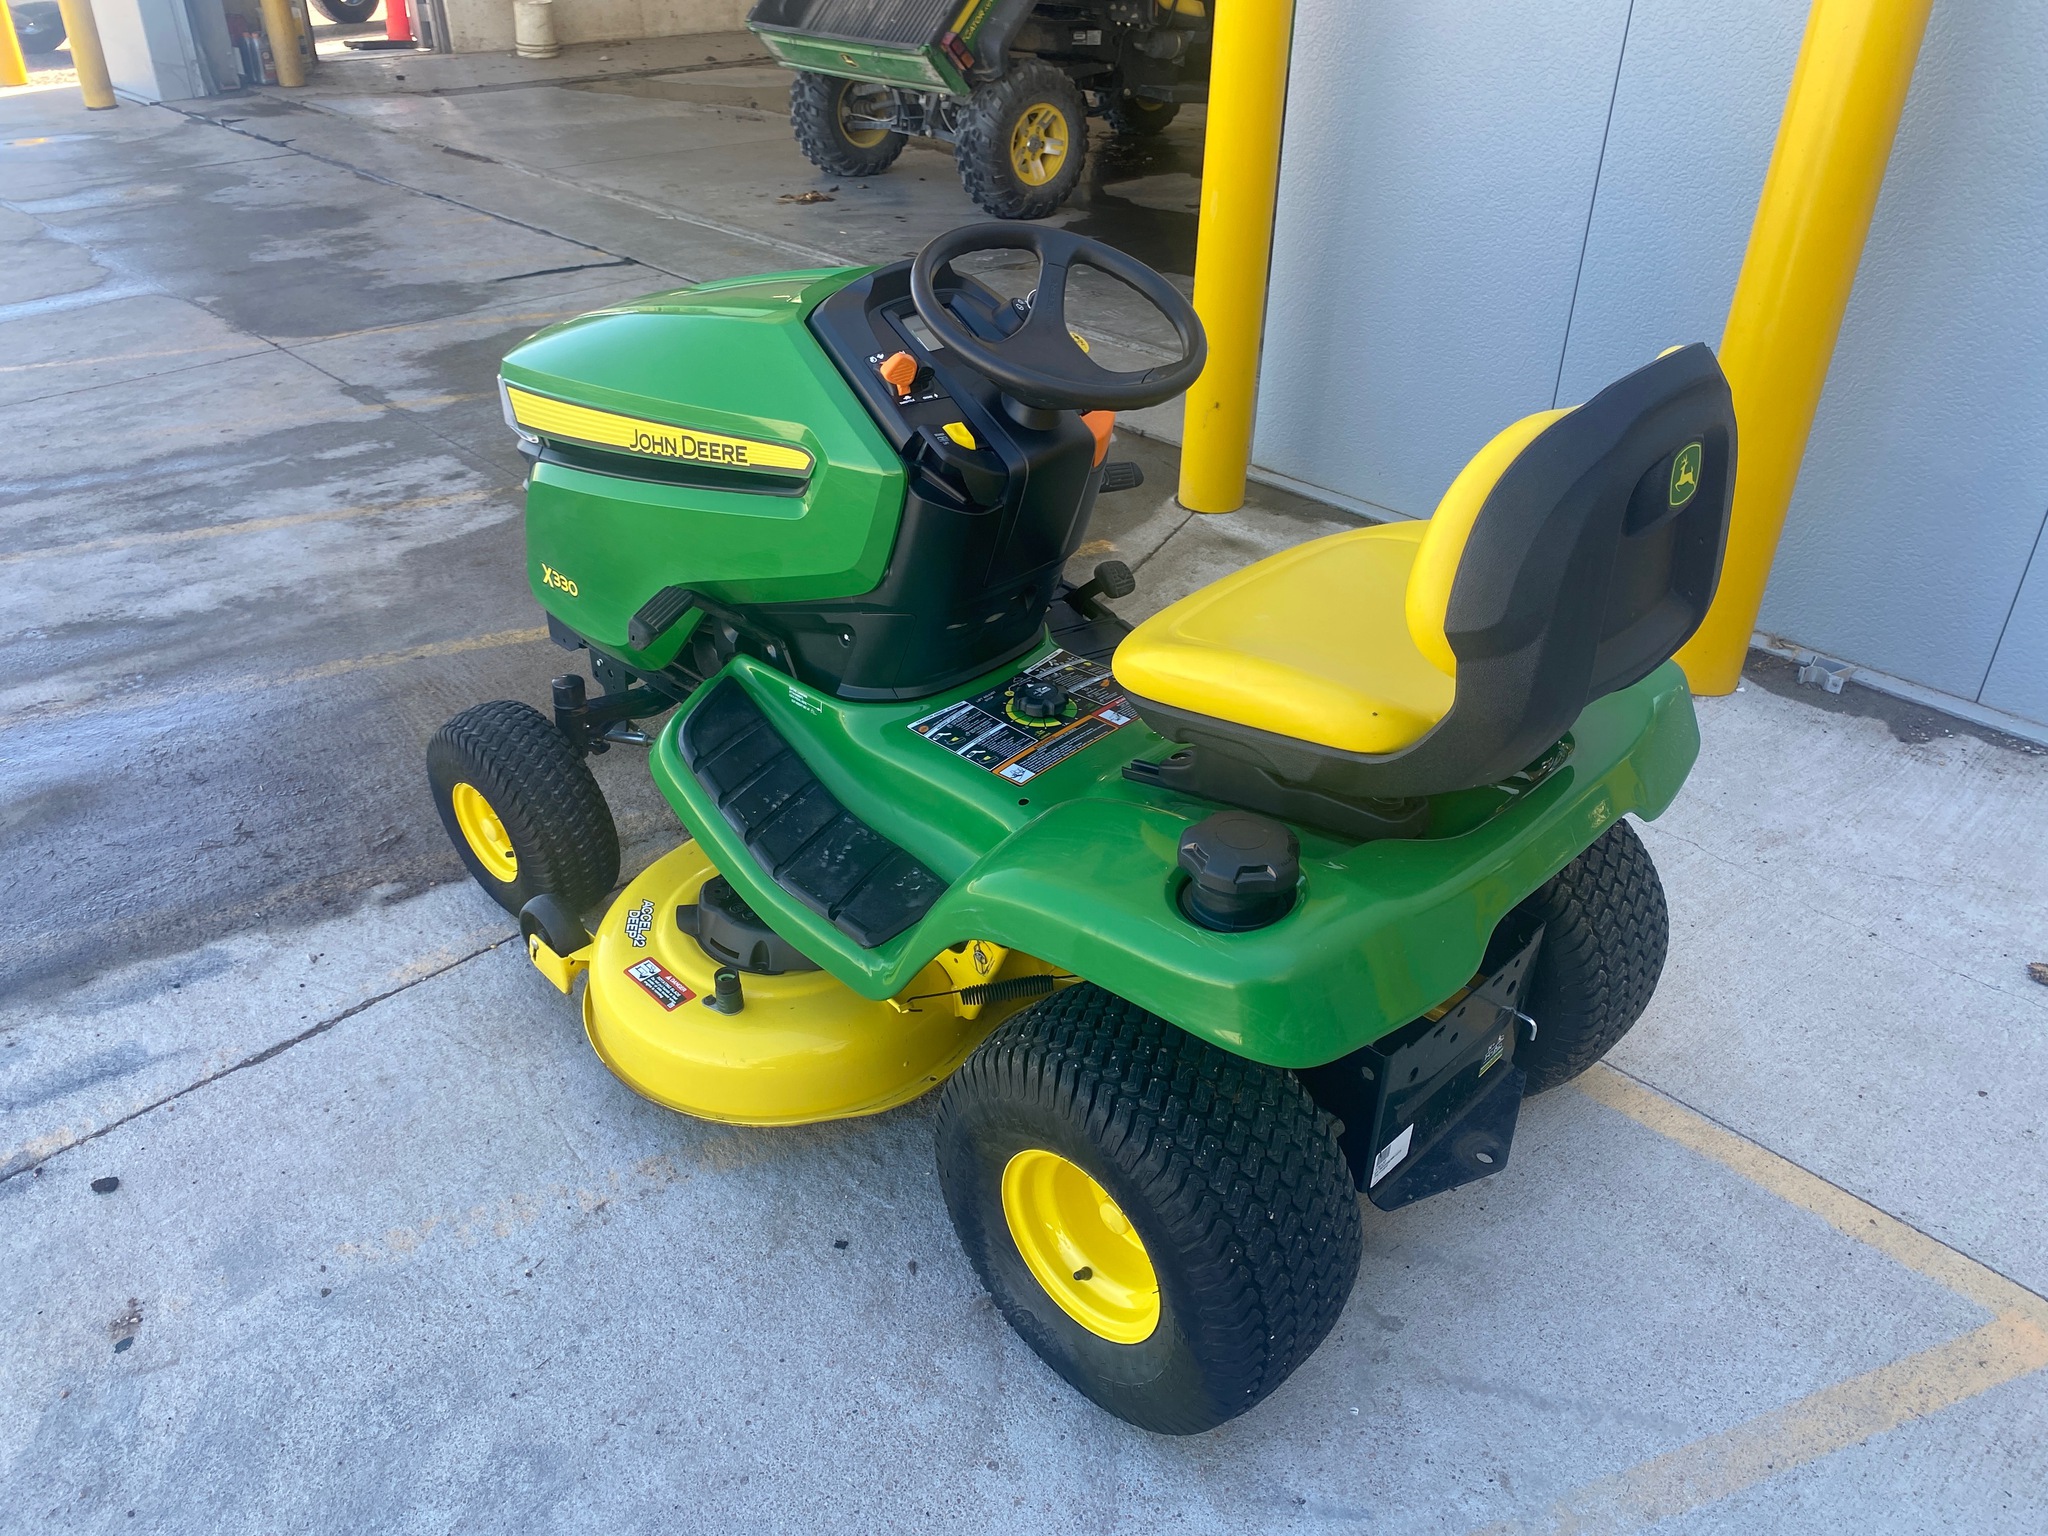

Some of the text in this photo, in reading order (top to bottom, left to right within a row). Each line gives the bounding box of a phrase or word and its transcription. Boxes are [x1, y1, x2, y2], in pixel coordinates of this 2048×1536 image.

[629, 428, 749, 463] JOHN DEERE
[541, 562, 579, 597] X330
[624, 909, 641, 940] DEEP
[638, 899, 655, 934] ACCEL
